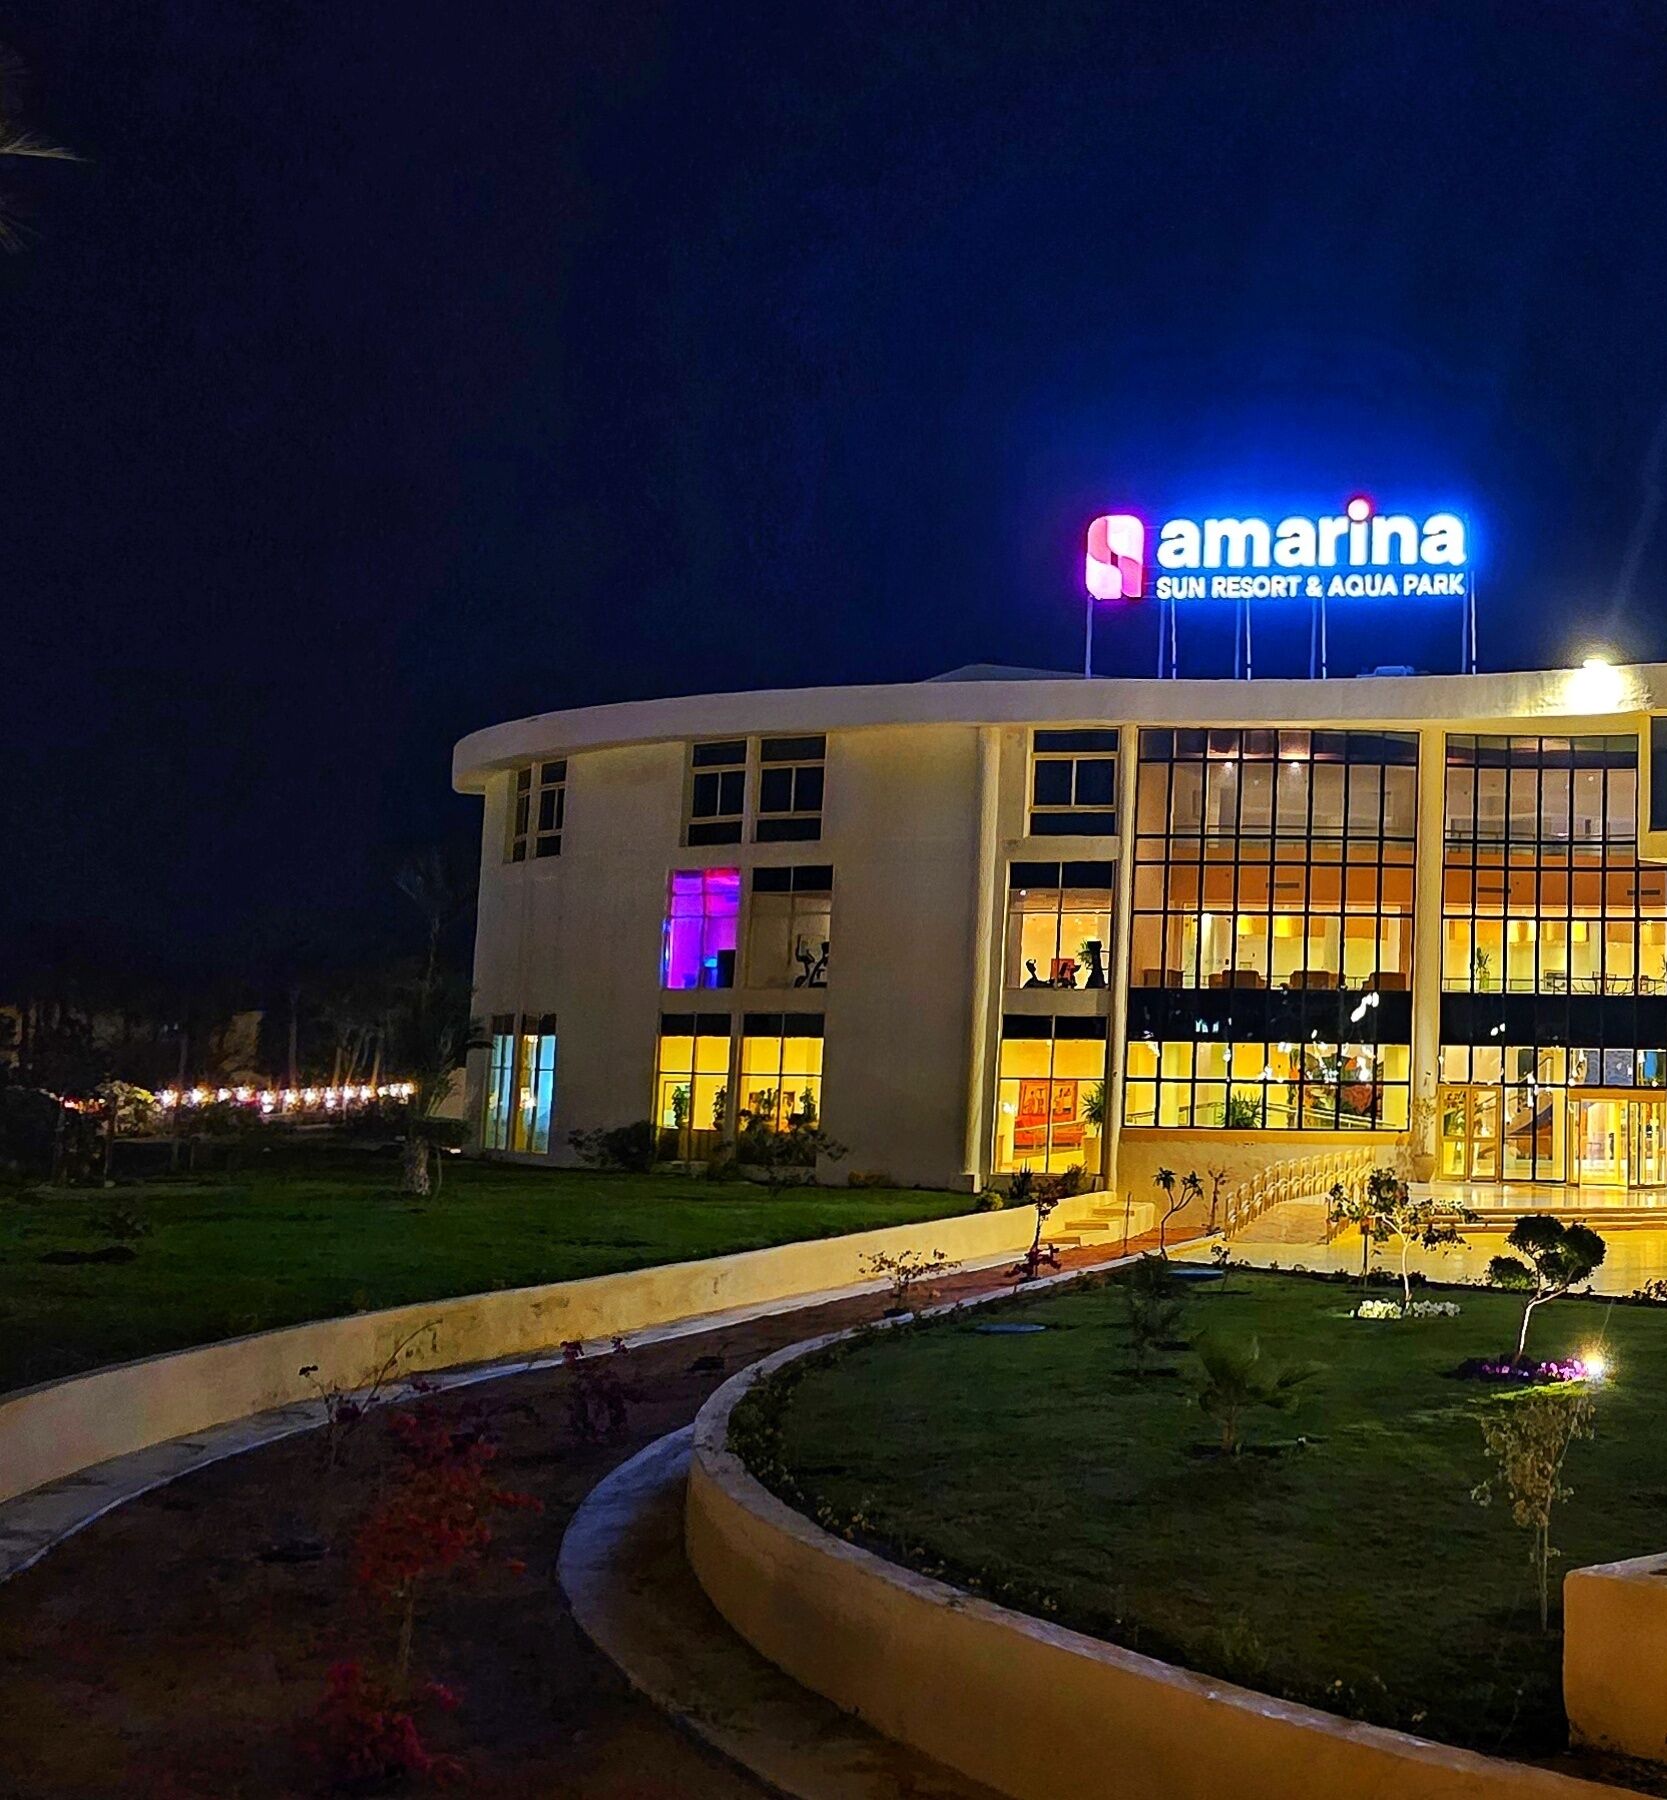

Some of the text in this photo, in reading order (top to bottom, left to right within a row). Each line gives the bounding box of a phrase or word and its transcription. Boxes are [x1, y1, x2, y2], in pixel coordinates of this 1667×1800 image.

[1157, 499, 1467, 567] amarina
[1156, 572, 1465, 599] SUN RESORT & AQUA PARK
